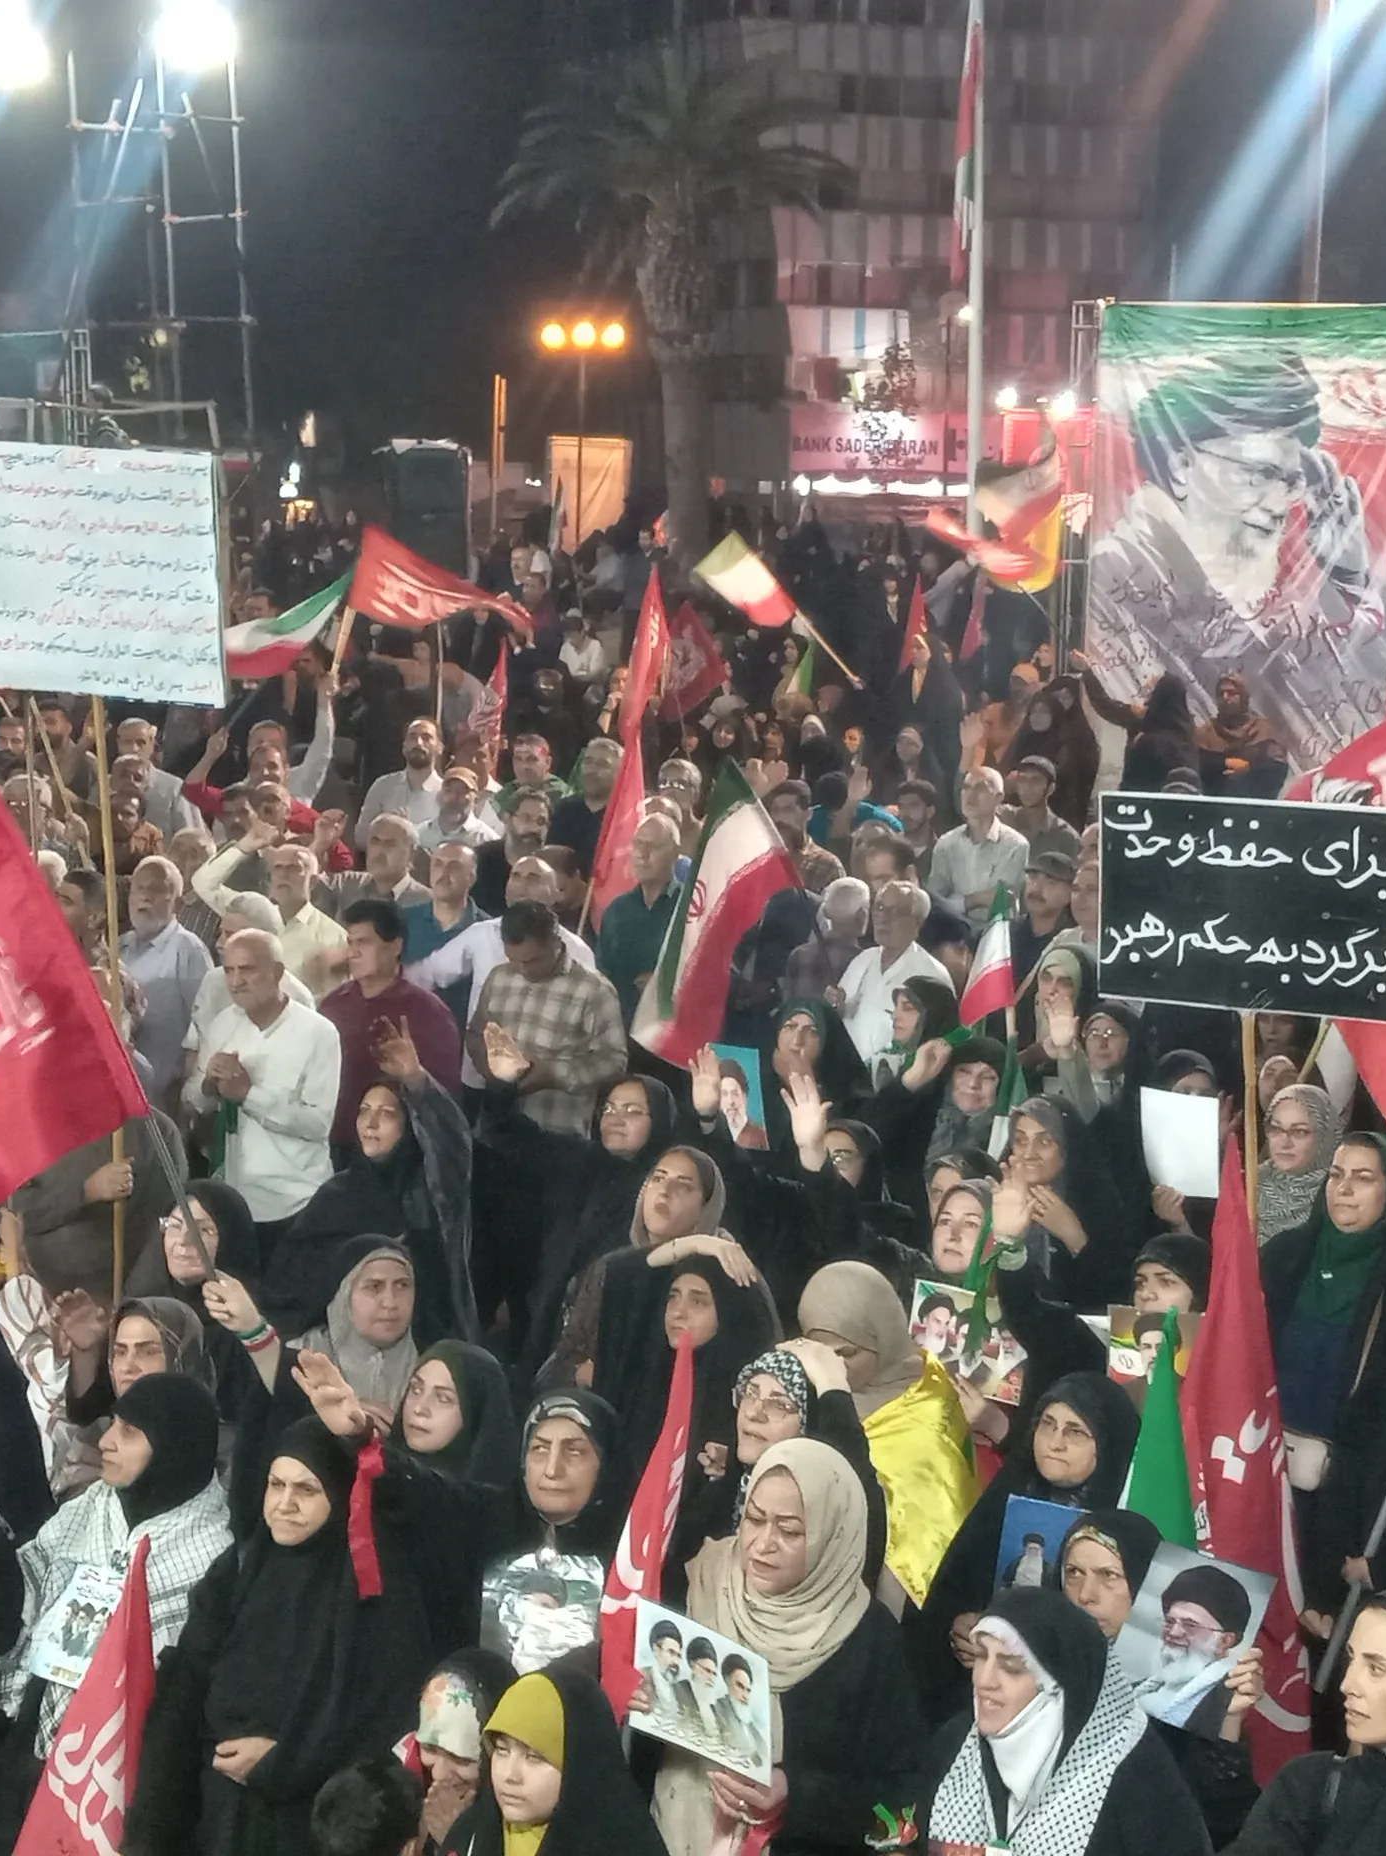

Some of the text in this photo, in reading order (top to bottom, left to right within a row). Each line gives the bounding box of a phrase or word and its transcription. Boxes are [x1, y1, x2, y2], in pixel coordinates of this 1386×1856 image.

[793, 435, 832, 452] BANK
[1103, 803, 1197, 868] وحدت
[1197, 818, 1293, 868] حفظ
[1099, 910, 1175, 966] رهبر
[1176, 911, 1252, 968] حکم
[1244, 936, 1298, 984] به
